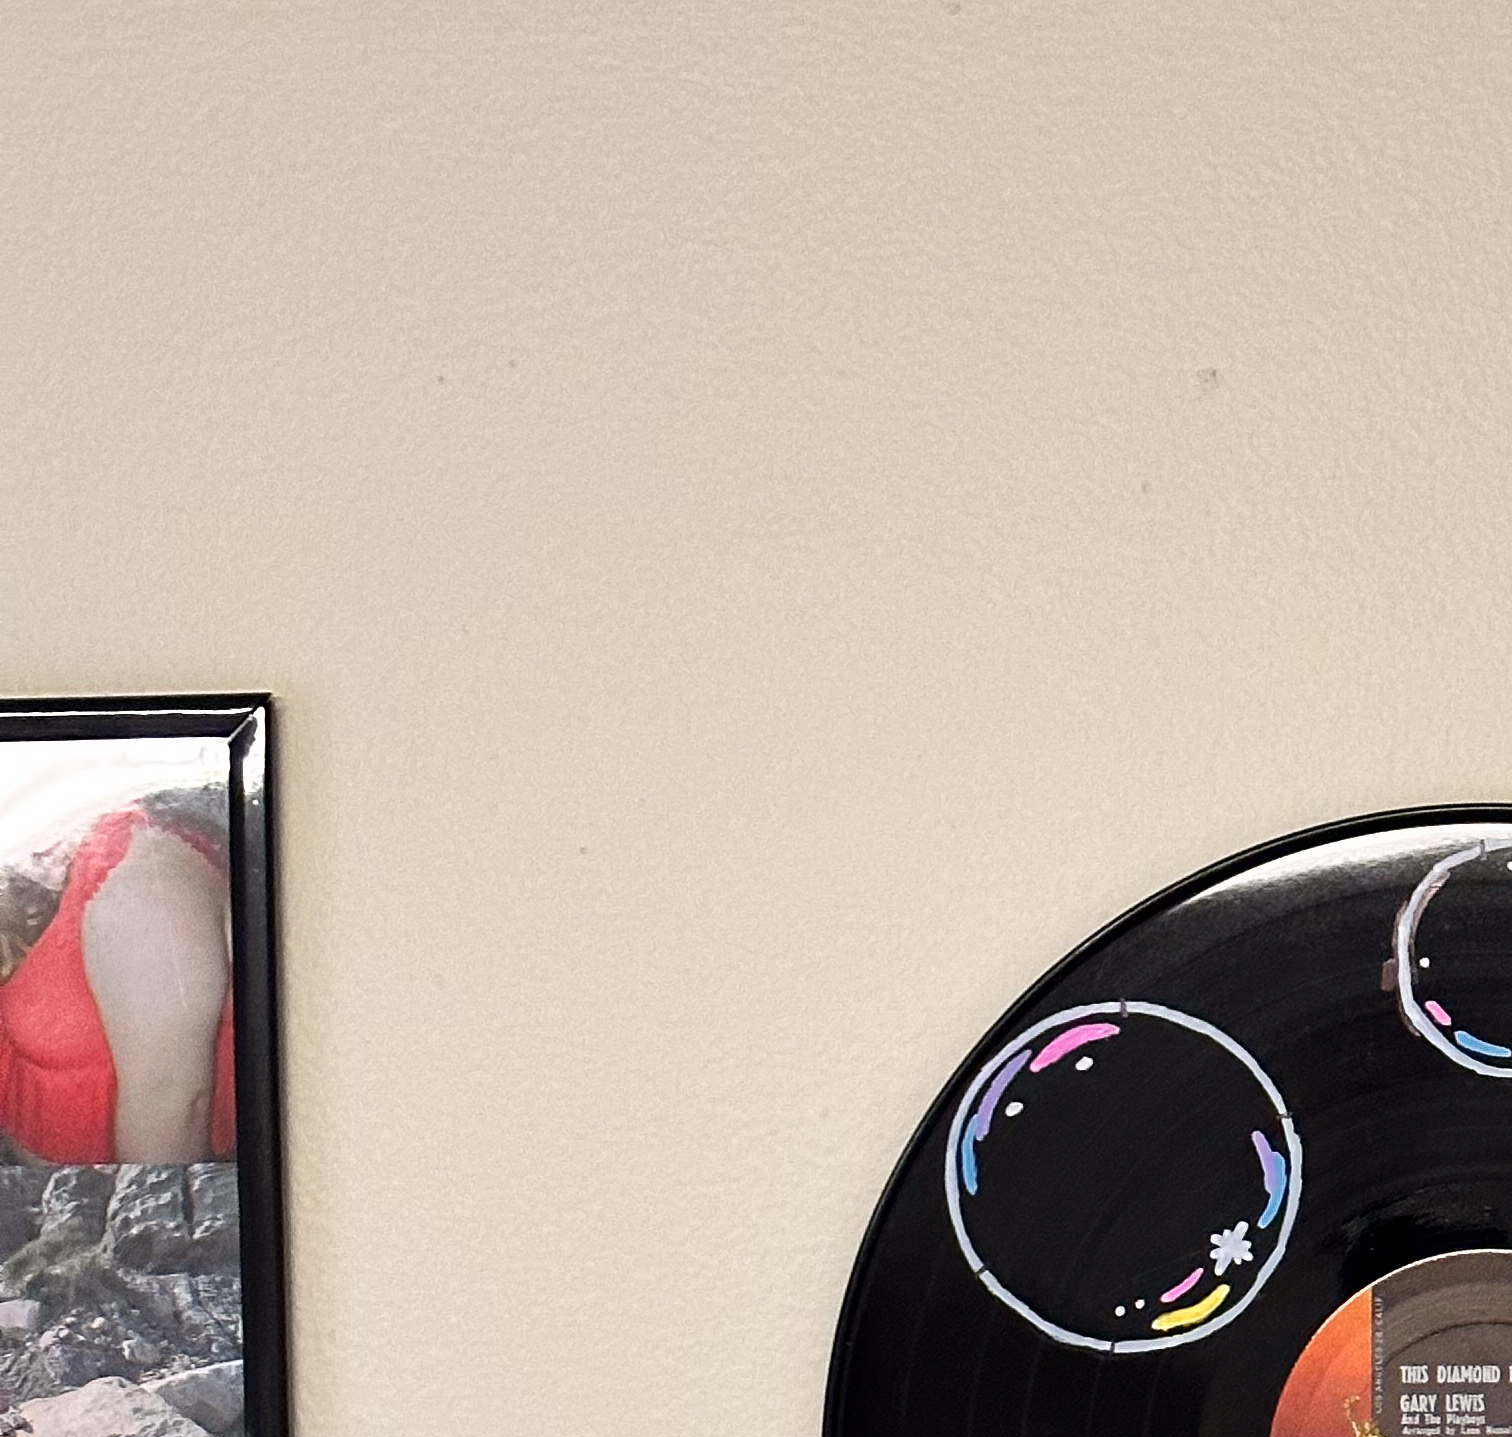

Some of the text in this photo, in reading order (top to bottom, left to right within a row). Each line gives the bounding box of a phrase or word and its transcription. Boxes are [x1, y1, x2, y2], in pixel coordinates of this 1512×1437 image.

[1400, 1365, 1429, 1383] THIS
[1437, 1365, 1501, 1383] DIAMOND
[1400, 1394, 1485, 1412] GARY LEWIS
[1424, 1414, 1441, 1424] The
